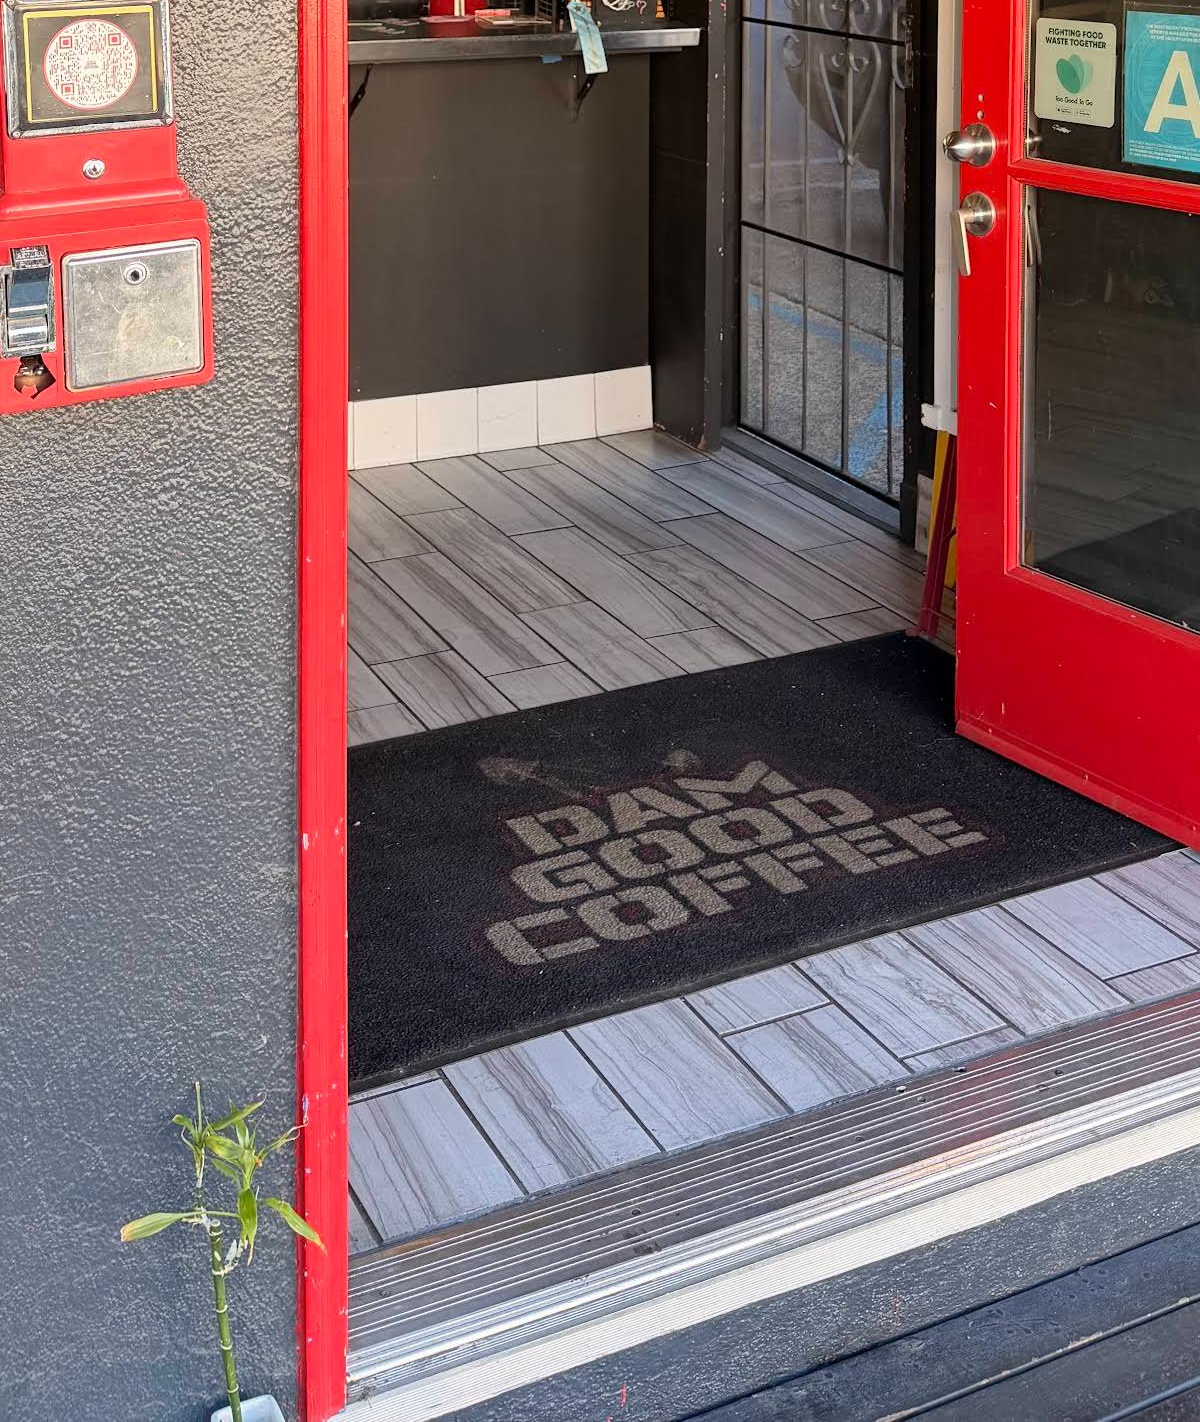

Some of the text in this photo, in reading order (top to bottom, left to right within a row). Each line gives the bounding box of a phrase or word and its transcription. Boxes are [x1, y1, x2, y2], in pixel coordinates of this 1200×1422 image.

[1045, 36, 1107, 50] WASTE TOGETHER
[1048, 27, 1103, 40] FIGHTING FOOD
[1064, 96, 1078, 105] Good
[1086, 98, 1093, 106] Go
[1143, 50, 1200, 139] A
[505, 759, 799, 856] DAM
[509, 787, 875, 904] GOOD
[485, 807, 990, 966] COFFEE
